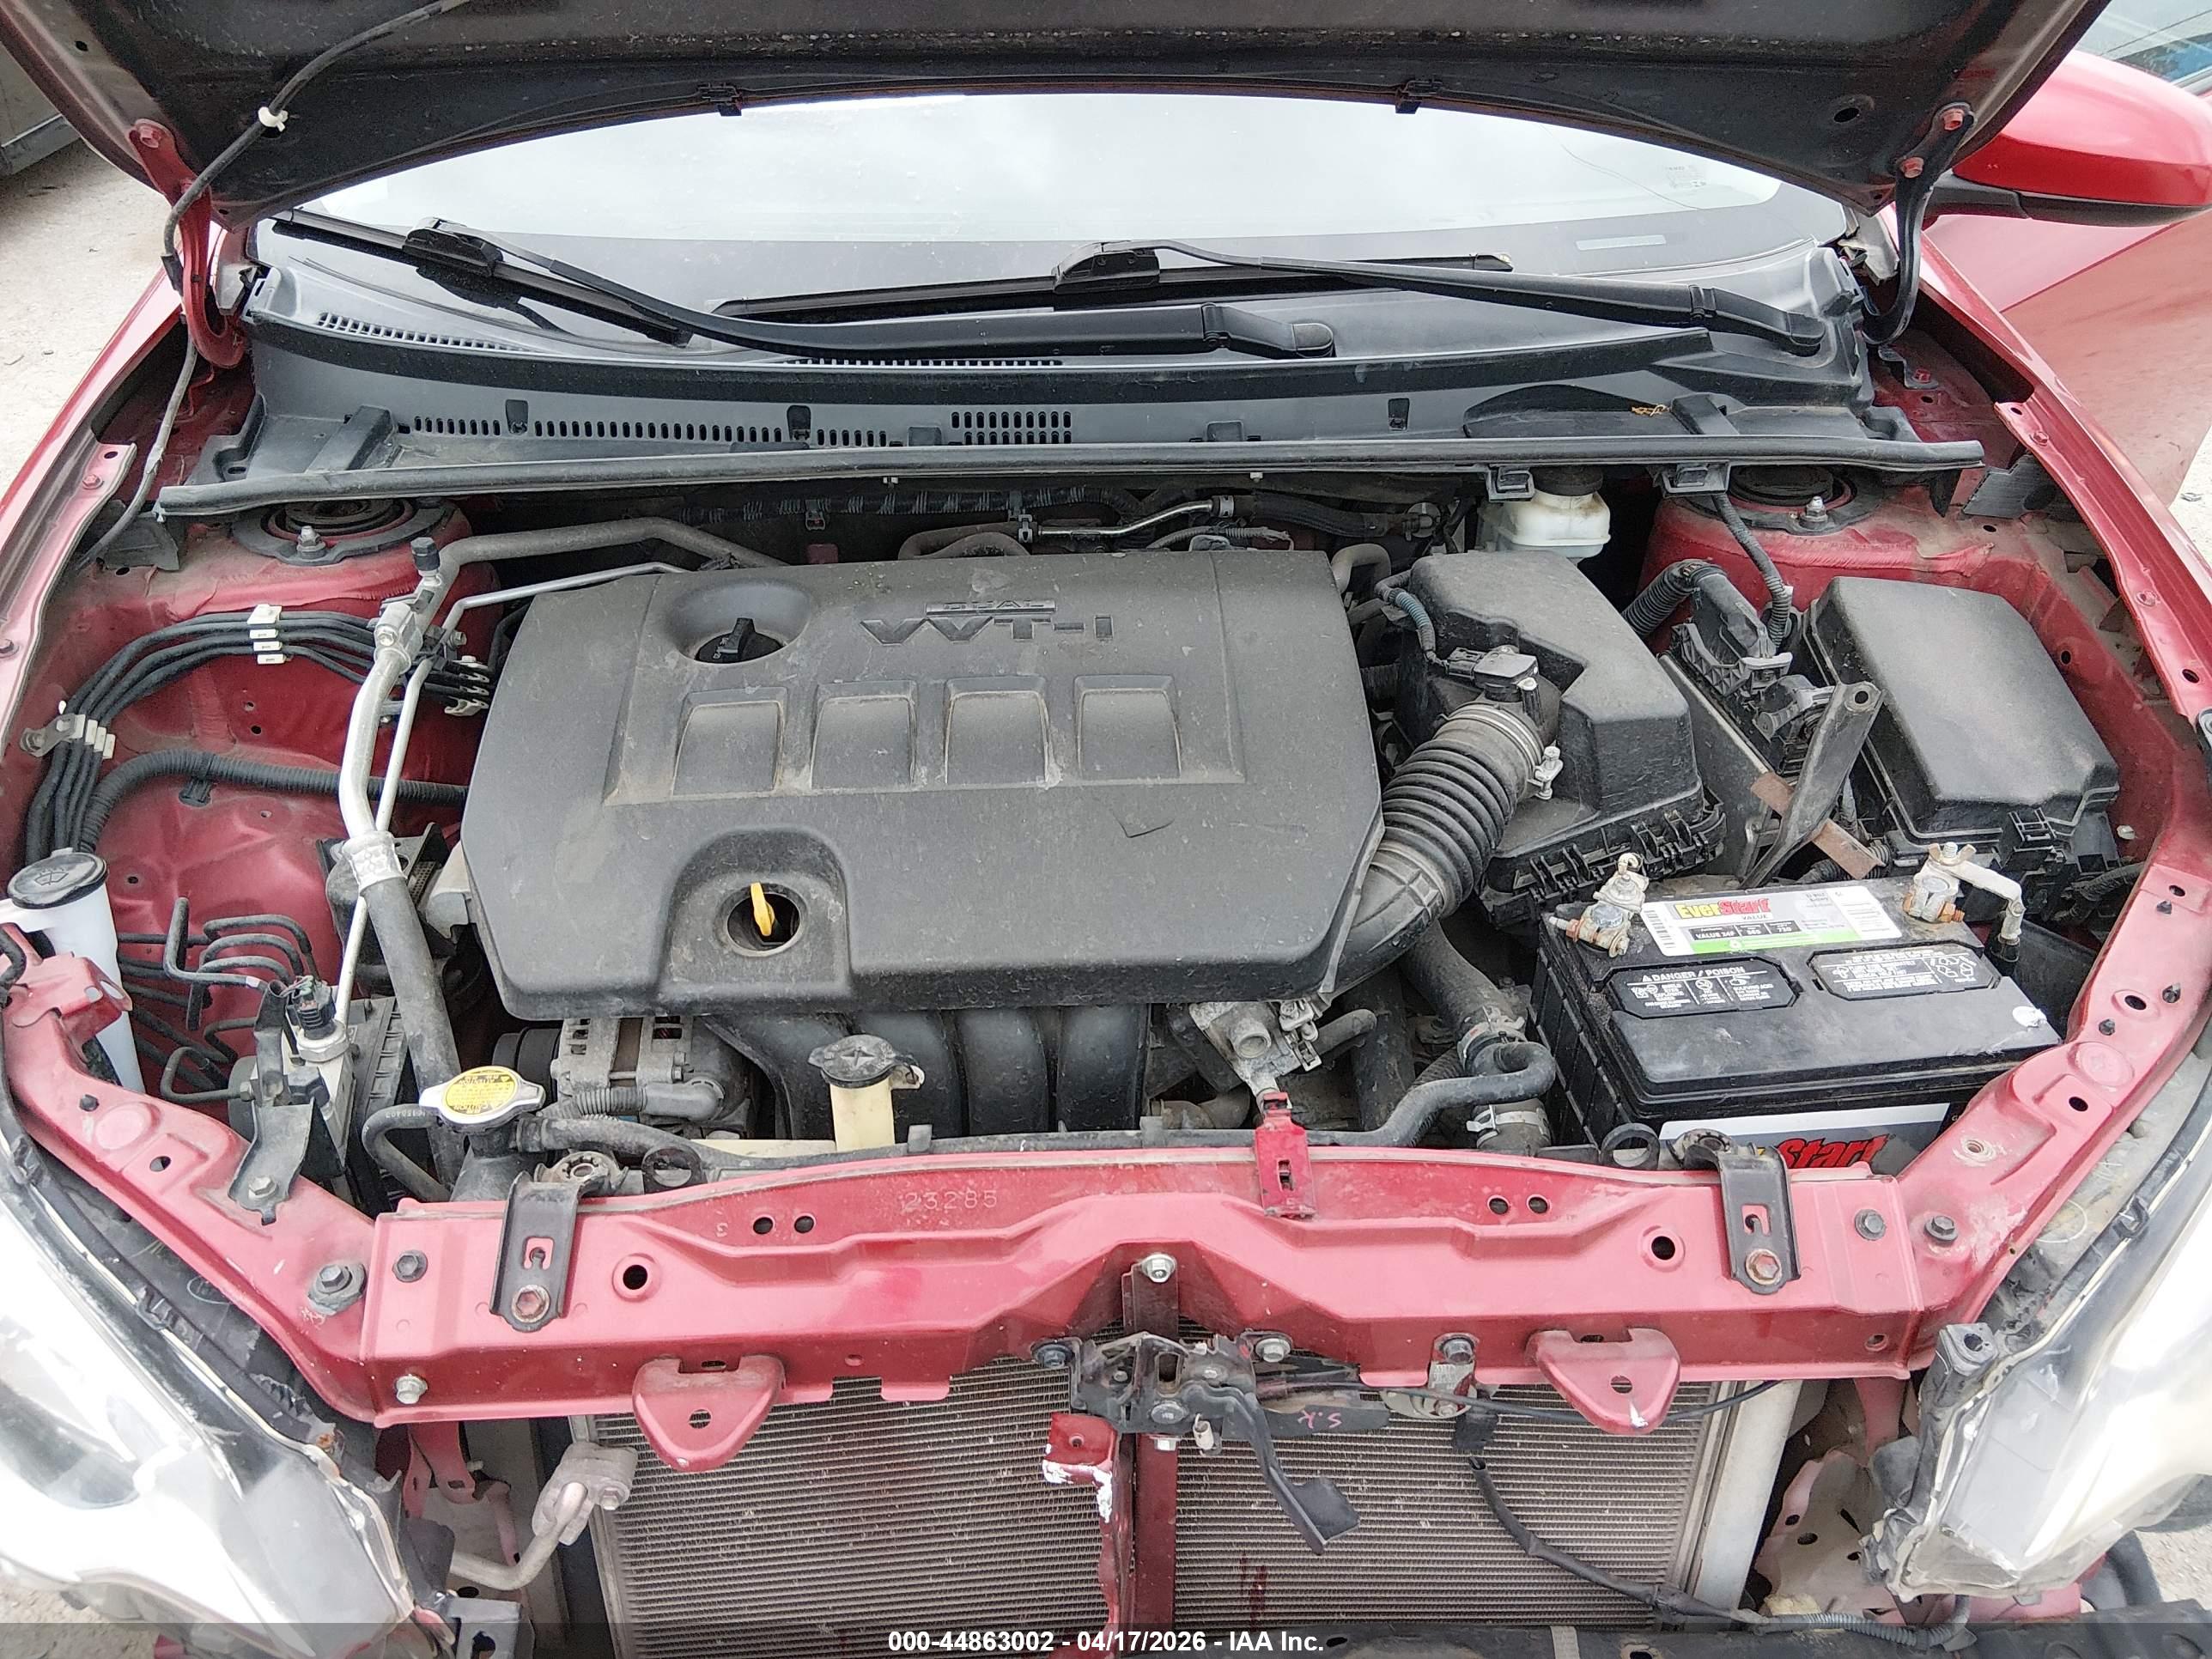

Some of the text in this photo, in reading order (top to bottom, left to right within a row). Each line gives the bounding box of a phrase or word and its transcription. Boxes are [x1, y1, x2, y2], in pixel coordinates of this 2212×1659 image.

[1674, 897, 1771, 920] EverStart
[1651, 971, 1697, 981] DANGER
[1705, 966, 1746, 977] POISON
[1775, 1133, 1889, 1169] Start
